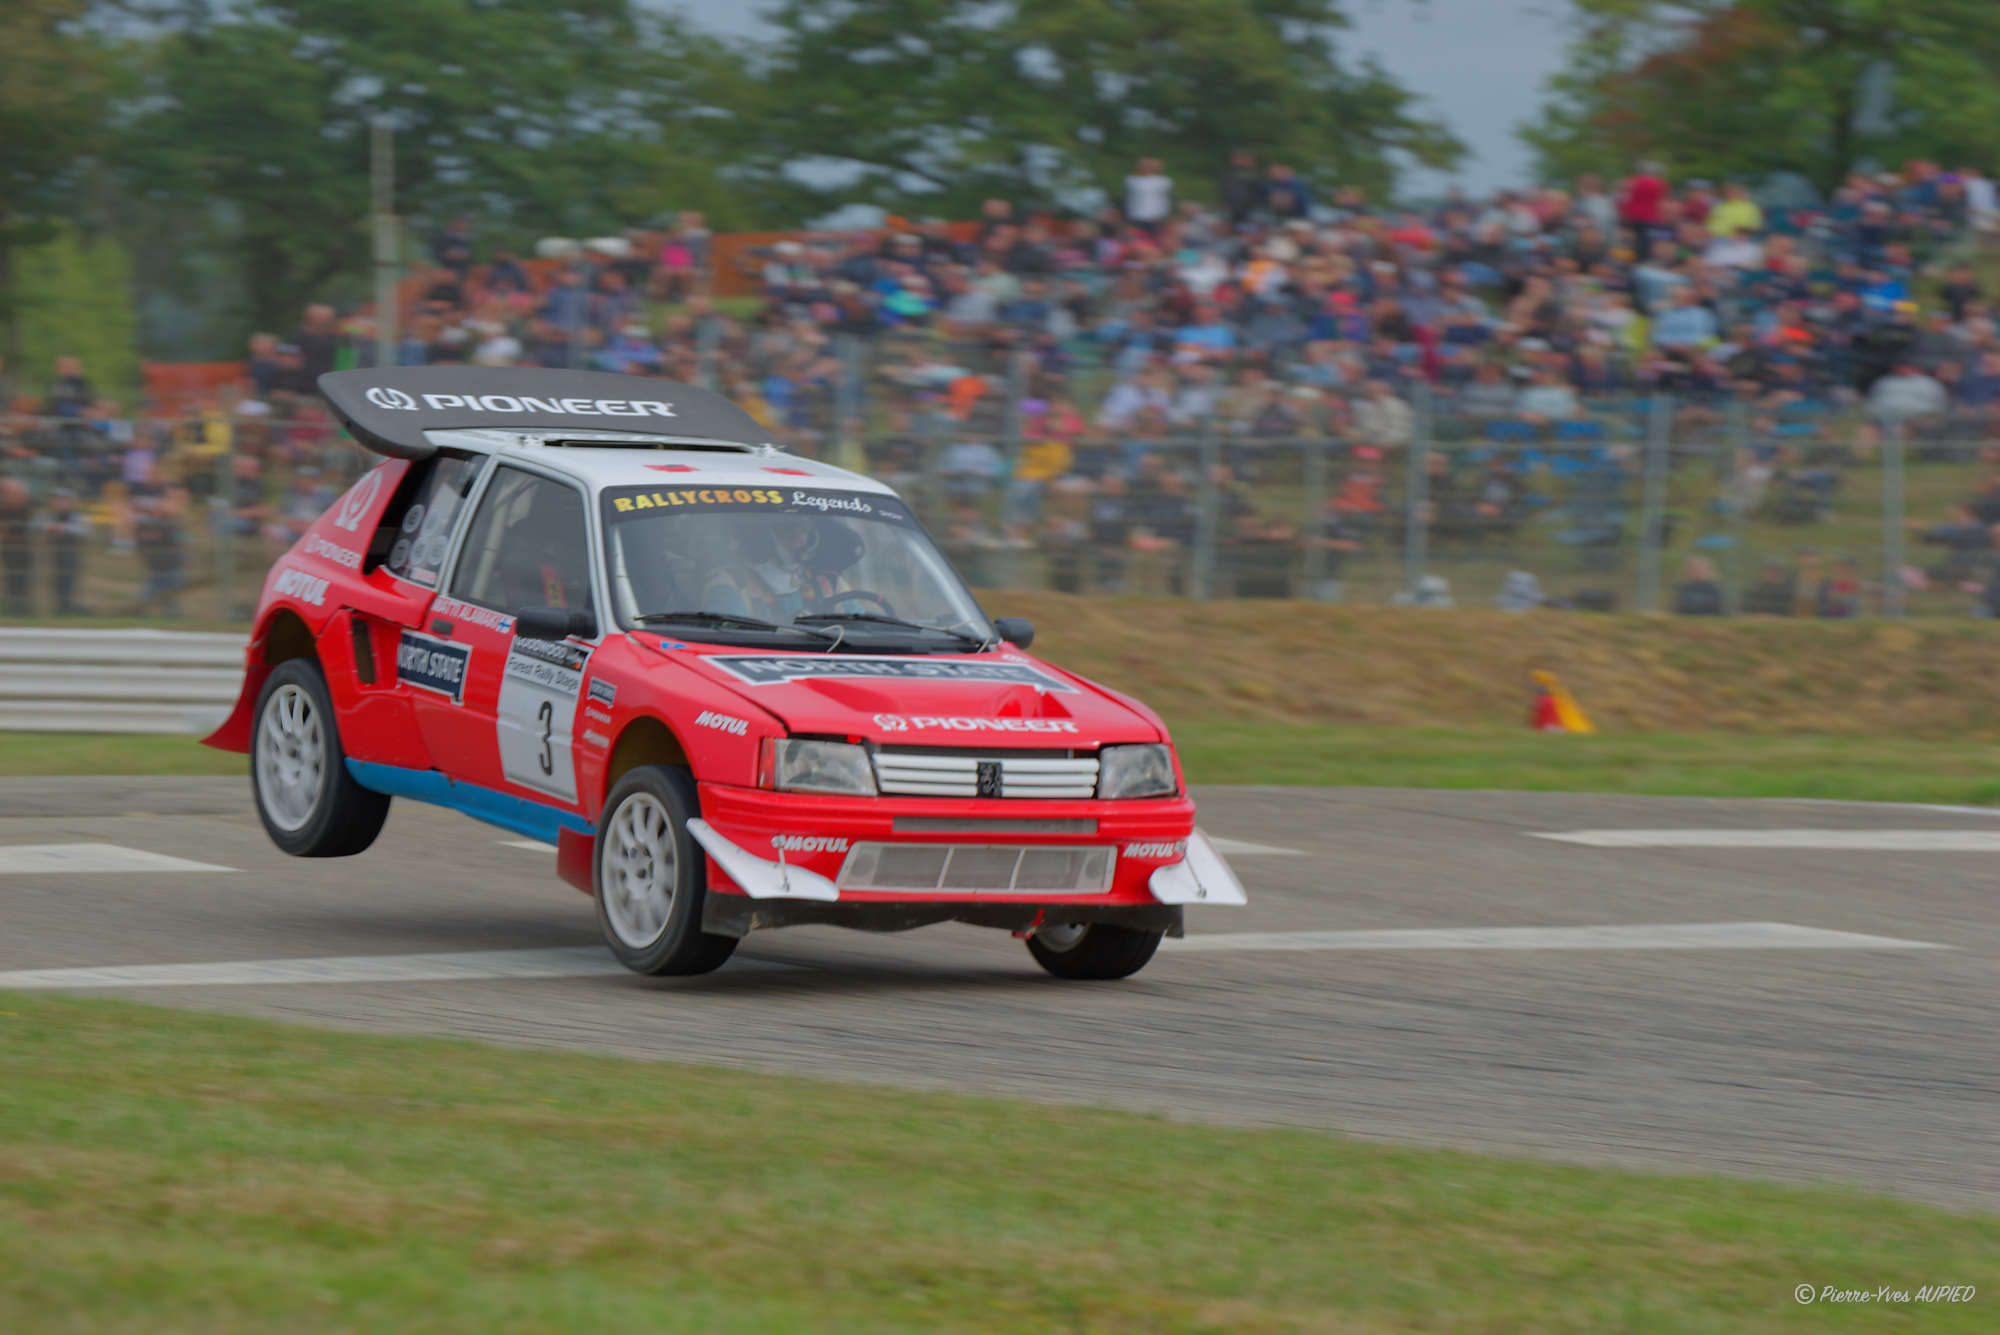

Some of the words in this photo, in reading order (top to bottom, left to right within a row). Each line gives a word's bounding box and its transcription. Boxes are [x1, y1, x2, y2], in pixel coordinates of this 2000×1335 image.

[422, 393, 678, 417] PIONEER
[613, 489, 784, 513] RALLYCROSS
[791, 490, 873, 512] Legends
[272, 567, 329, 607] MOTUL
[427, 652, 464, 684] STATE
[534, 664, 554, 687] Rally
[738, 659, 902, 675] NORTH
[903, 662, 1042, 681] STATE
[694, 710, 749, 736] MOTUL
[912, 716, 1079, 733] PIONEER
[538, 700, 553, 777] 3
[783, 835, 848, 853] MOTUL
[1122, 842, 1176, 857] MOTUL
